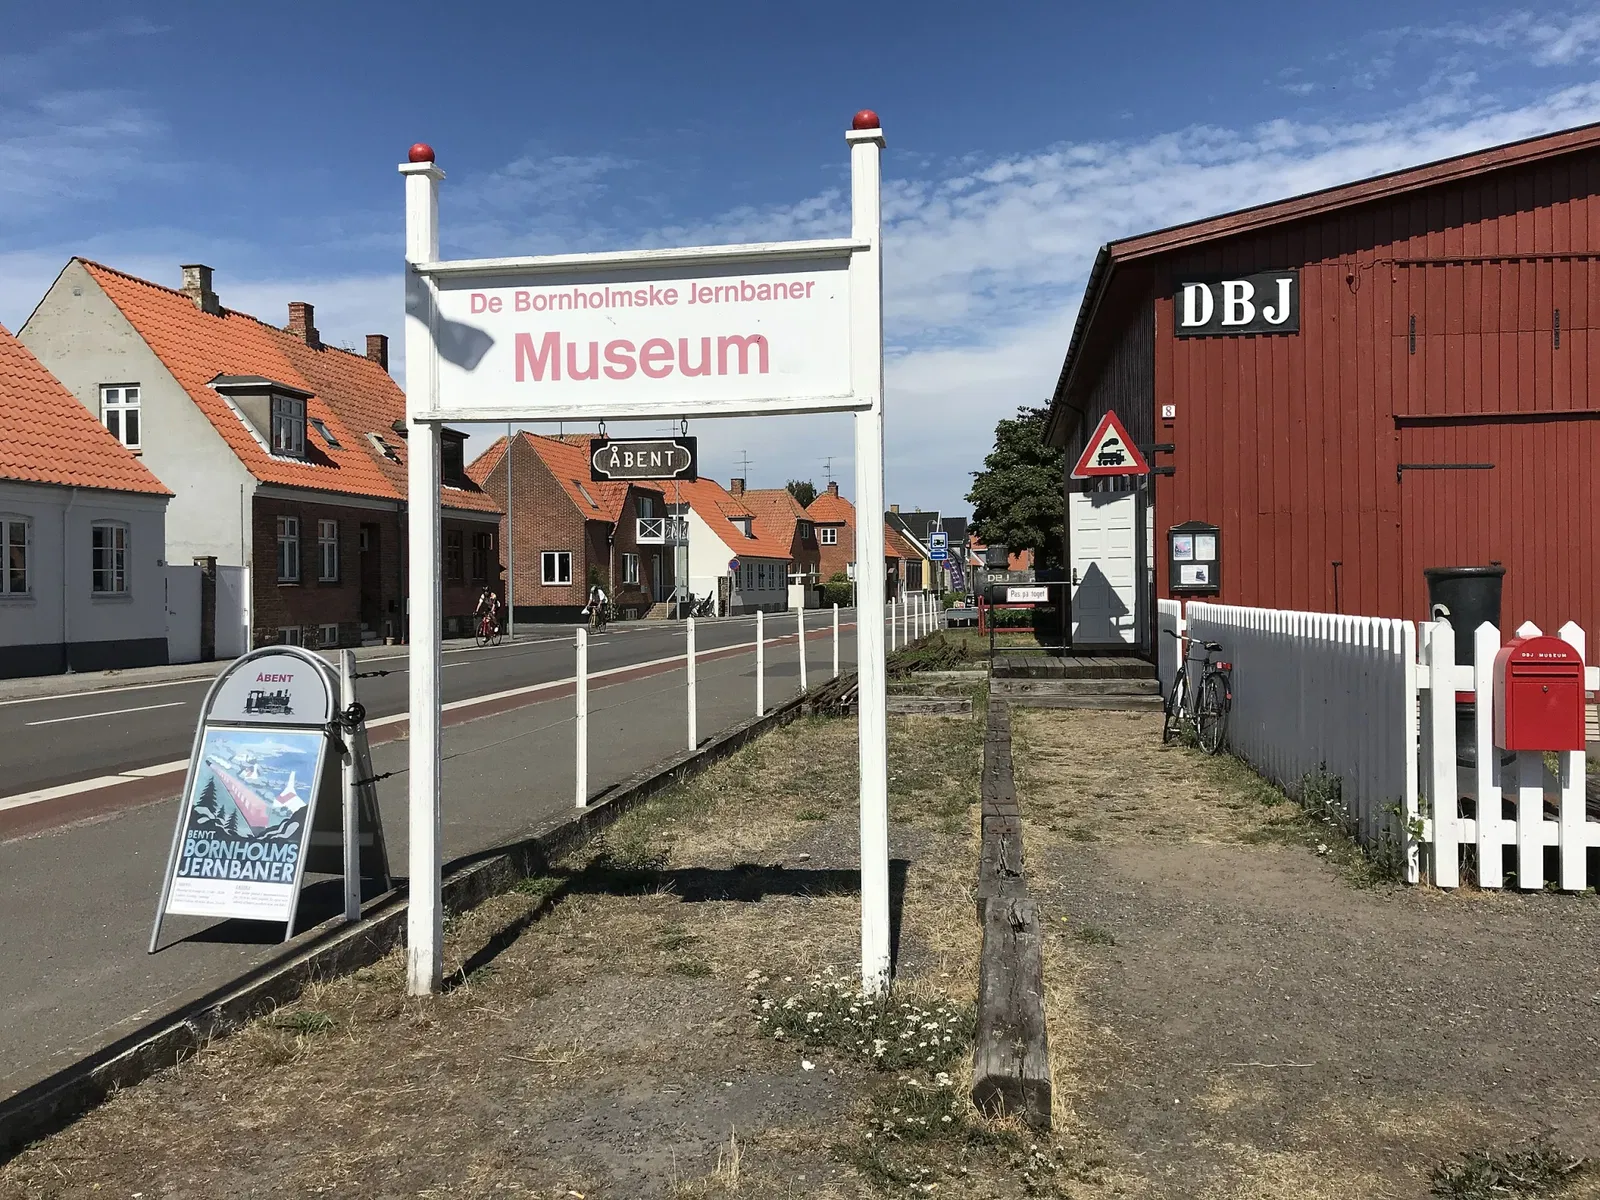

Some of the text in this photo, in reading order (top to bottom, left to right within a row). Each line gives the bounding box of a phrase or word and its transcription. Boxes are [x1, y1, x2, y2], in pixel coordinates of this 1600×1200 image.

[471, 279, 815, 314] De Bornholmske Jernbaner
[1181, 278, 1293, 327] DBJ
[514, 331, 769, 383] Museum
[1165, 405, 1172, 416] 8
[610, 446, 674, 468] ÅBENT
[256, 672, 294, 683] ÅBENT
[187, 829, 216, 839] BENYT
[184, 839, 298, 863] BORNHOLMS
[179, 858, 294, 881] JERNBANER
